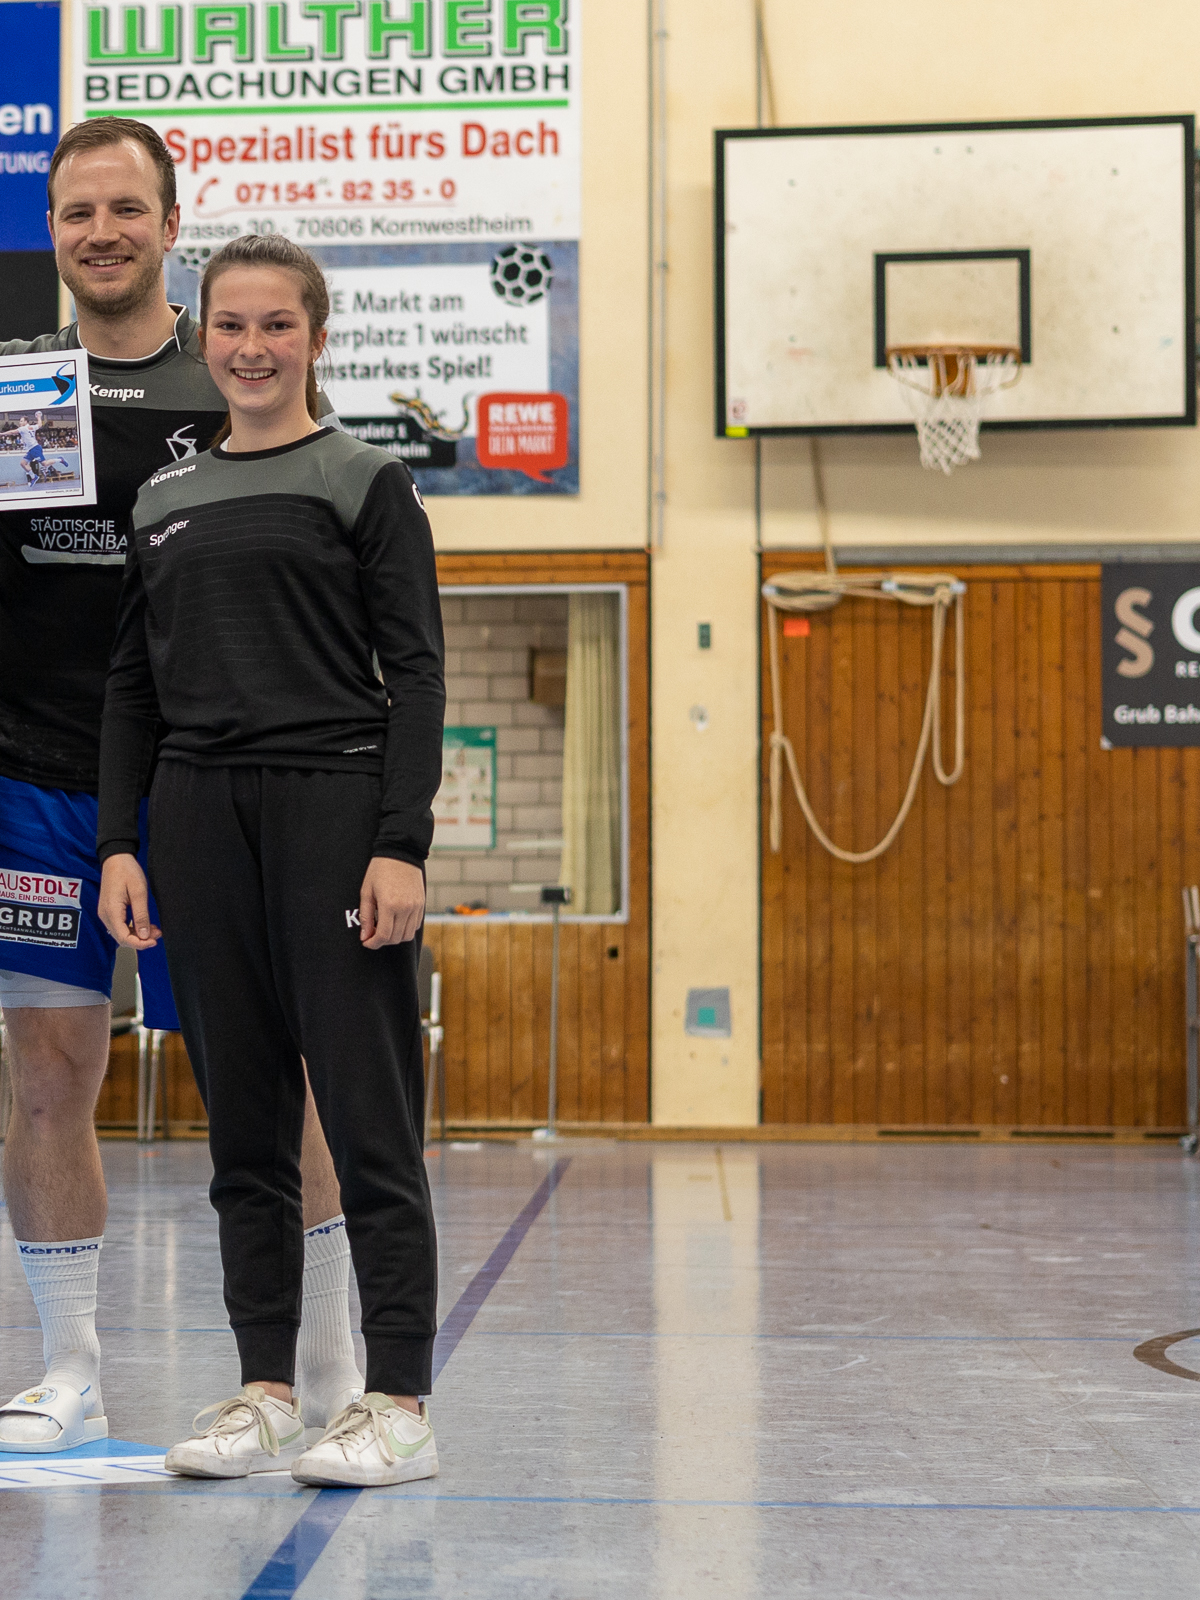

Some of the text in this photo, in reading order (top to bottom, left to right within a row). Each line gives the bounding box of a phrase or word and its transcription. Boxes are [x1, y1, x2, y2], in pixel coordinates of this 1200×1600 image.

[84, 0, 569, 65] WALTHER
[84, 63, 570, 102] BEDACHUNGEN GMBH
[163, 120, 560, 173] Spezialist fürs Dach
[235, 181, 316, 205] 07154
[342, 179, 377, 202] 82
[383, 179, 414, 201] 35
[439, 178, 456, 200] 0
[298, 215, 364, 238] 70806
[371, 213, 532, 237] Kornwestheim
[353, 289, 421, 313] Markt
[429, 294, 465, 313] am
[415, 324, 425, 345] 1
[431, 322, 529, 346] wünscht
[427, 355, 493, 383] Spiel!
[89, 383, 145, 401] Kempa
[488, 401, 557, 424] REWE
[150, 464, 197, 487] Kempa
[30, 516, 115, 533] STÄDTISCHE
[1113, 704, 1161, 725] Grub
[32, 895, 56, 904] PREIS.
[18, 1243, 99, 1255] Kempa
